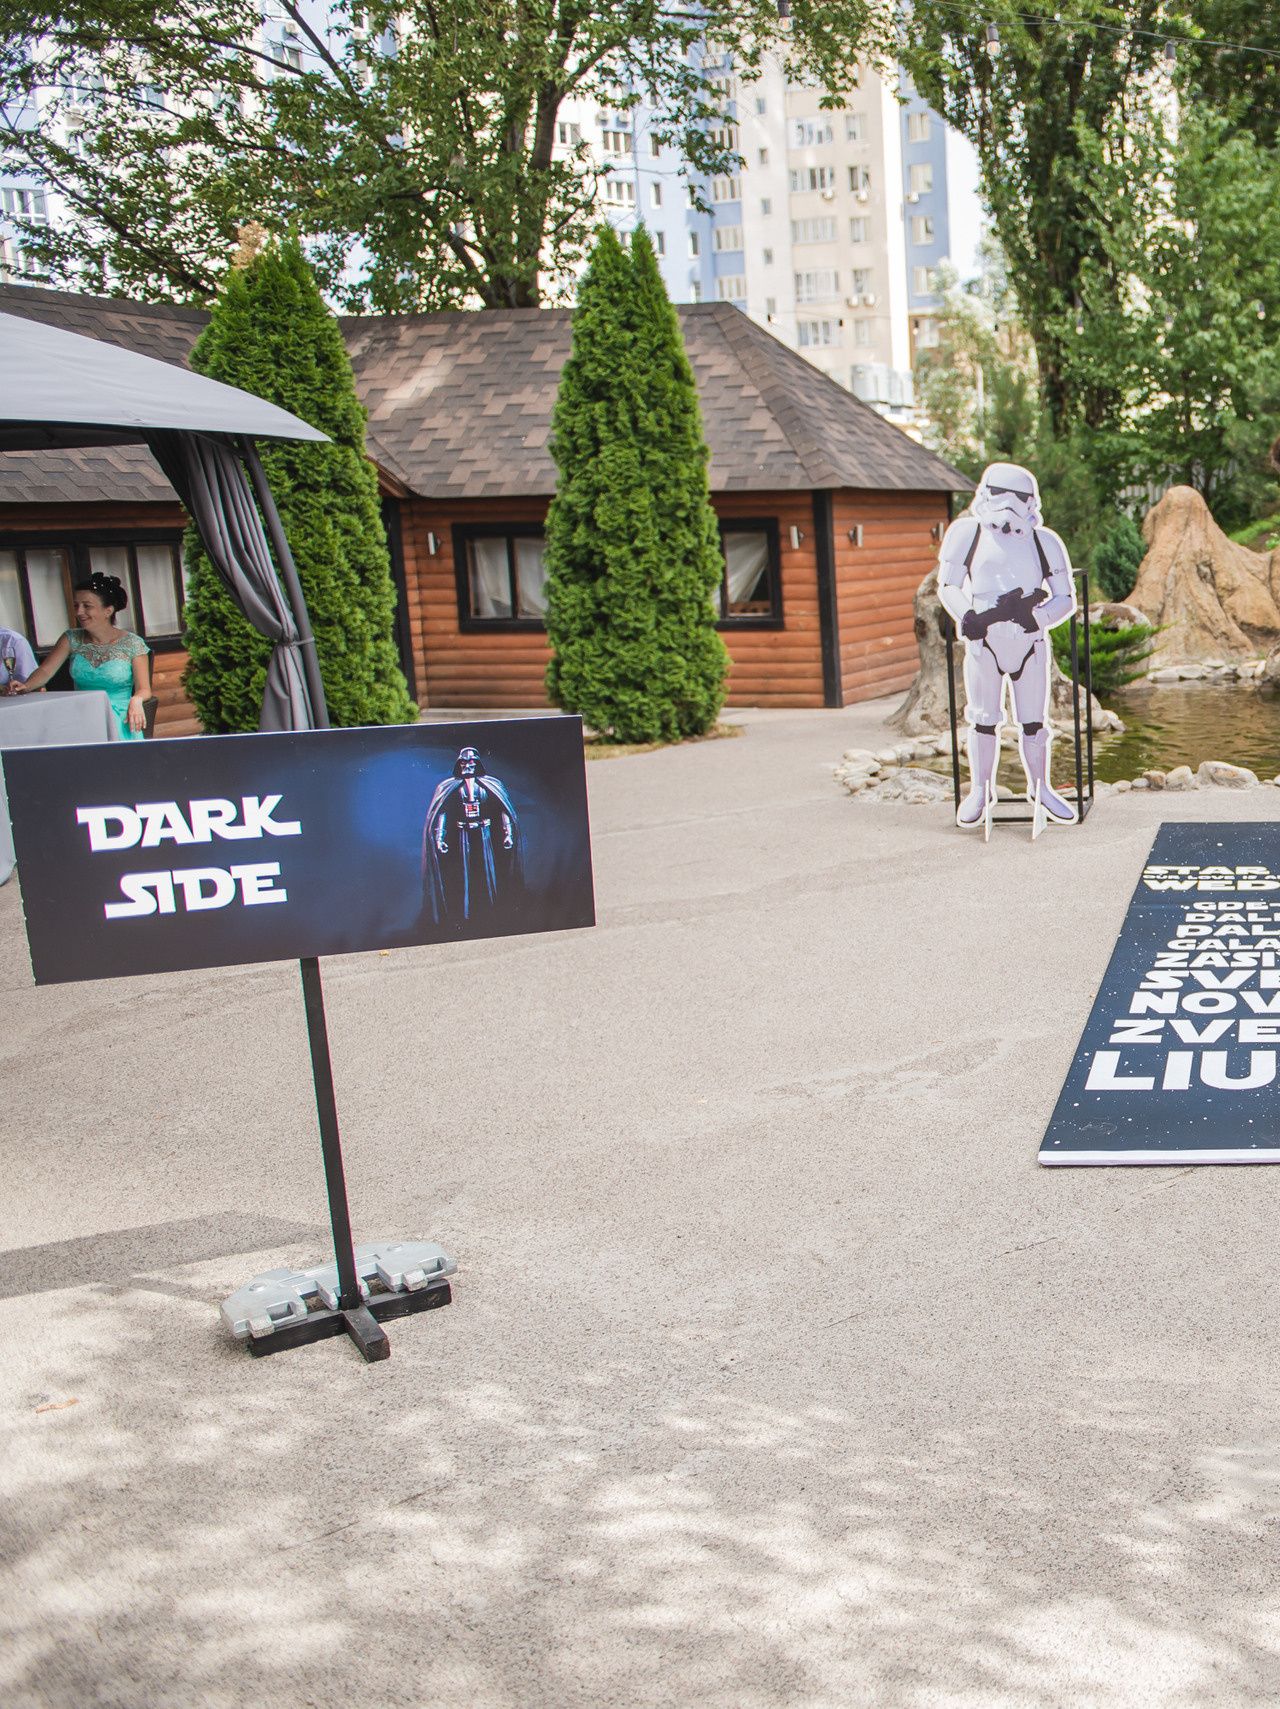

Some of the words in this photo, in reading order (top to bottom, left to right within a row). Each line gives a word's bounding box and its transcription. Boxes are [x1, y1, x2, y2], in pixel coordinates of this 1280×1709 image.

[76, 794, 302, 853] DARK
[104, 861, 288, 919] SIDE
[1143, 865, 1271, 875] STAR
